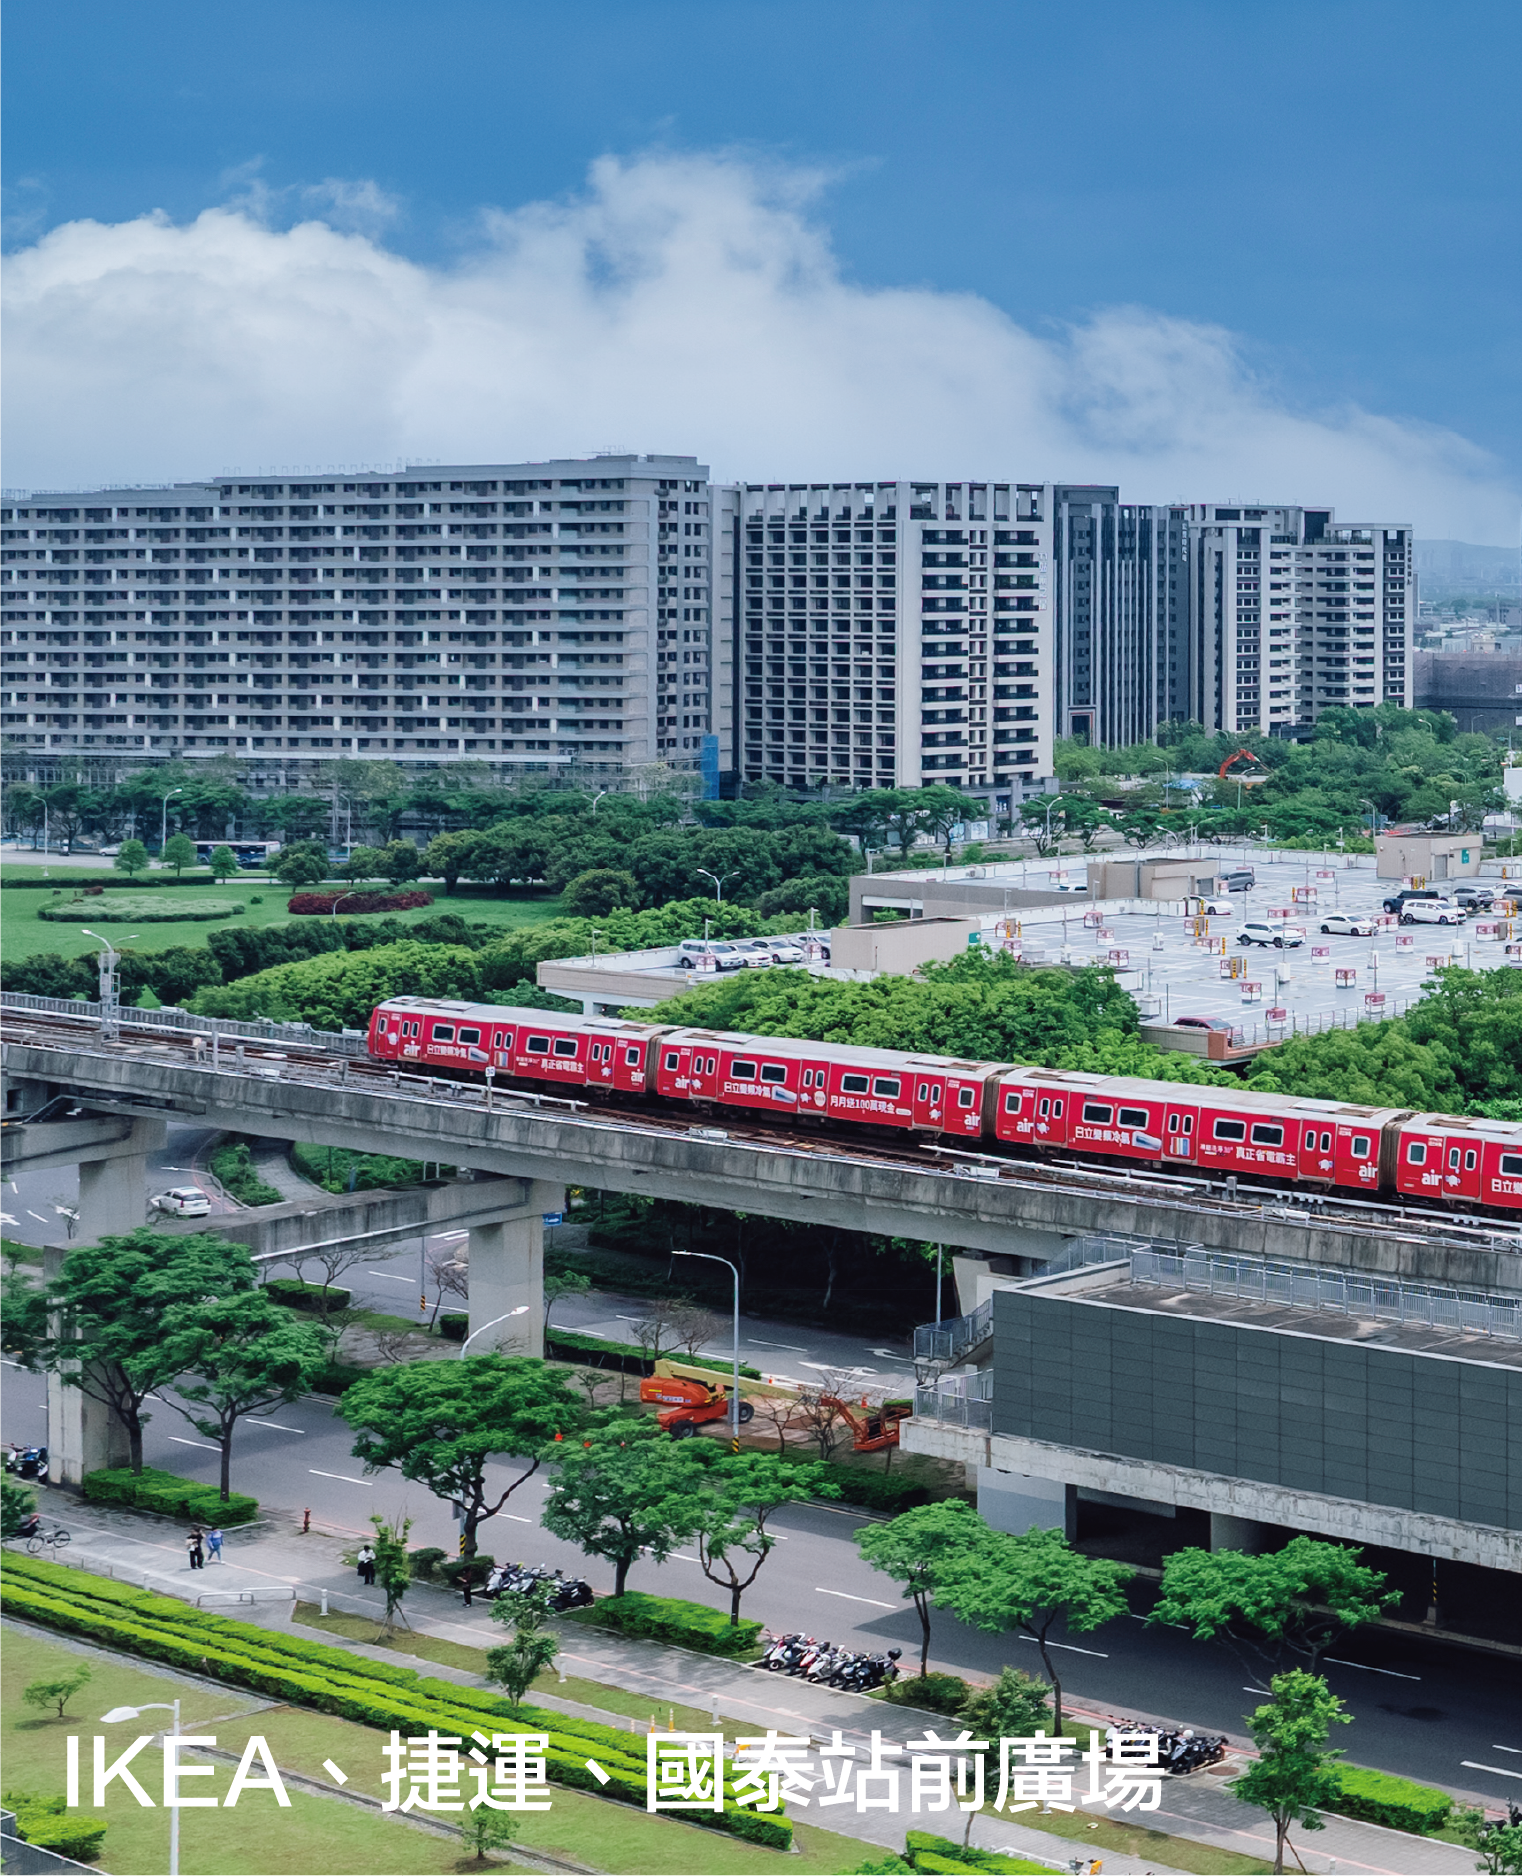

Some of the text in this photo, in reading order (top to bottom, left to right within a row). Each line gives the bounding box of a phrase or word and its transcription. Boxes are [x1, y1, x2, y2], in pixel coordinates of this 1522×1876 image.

[403, 1040, 421, 1057] air
[630, 1069, 645, 1083] air
[675, 1074, 690, 1089] air
[830, 1095, 895, 1114] 月月送100萬現金
[964, 1112, 981, 1127] air
[1016, 1118, 1034, 1133] air
[1358, 1162, 1379, 1178] air
[1421, 1169, 1442, 1186] air
